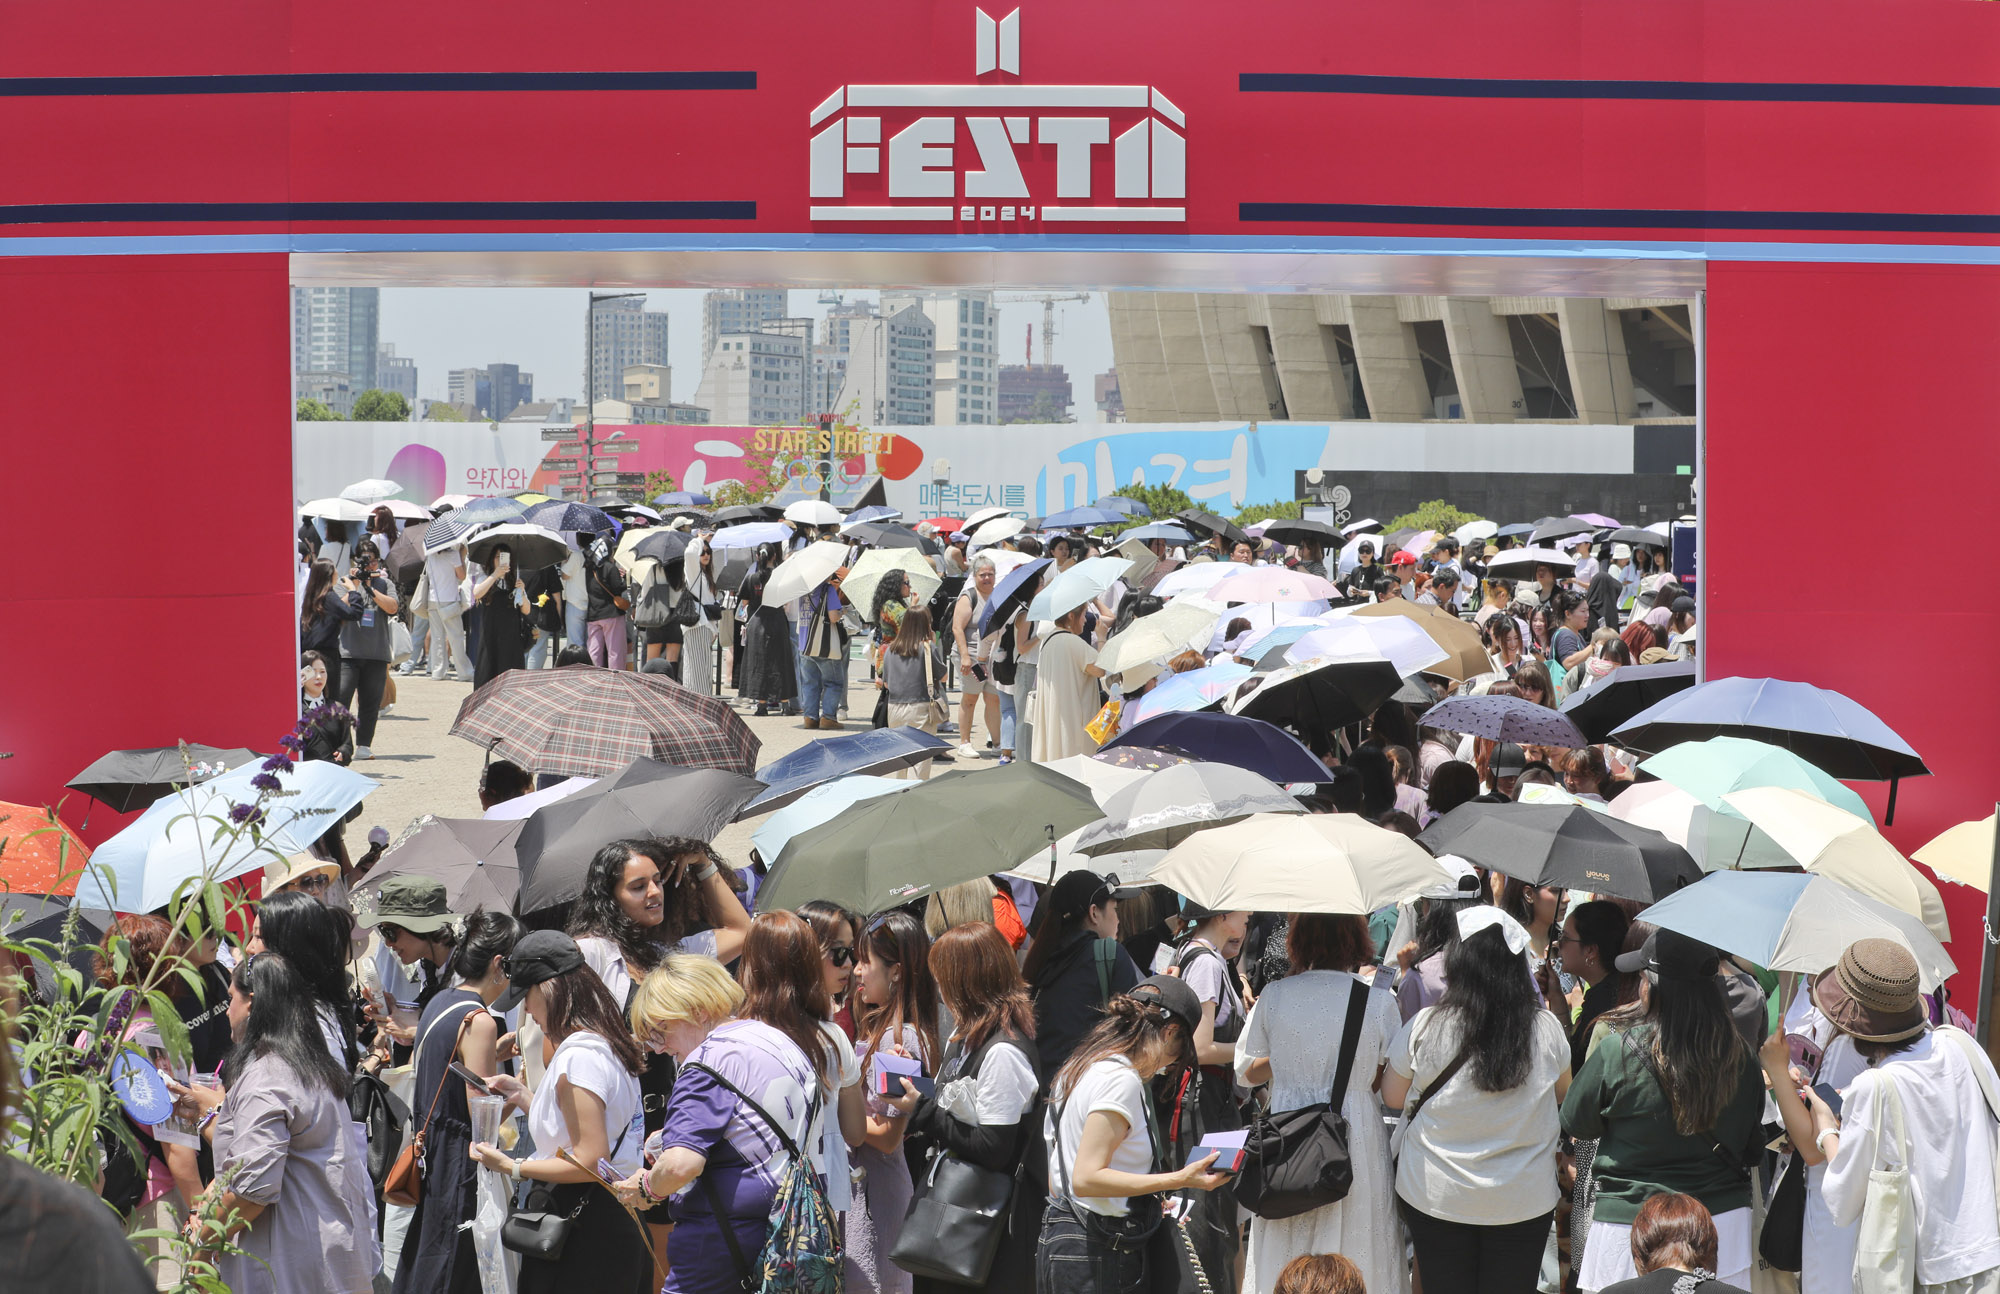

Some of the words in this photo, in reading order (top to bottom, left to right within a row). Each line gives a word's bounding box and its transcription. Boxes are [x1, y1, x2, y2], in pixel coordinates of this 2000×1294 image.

[810, 117, 1186, 198] FESTA
[960, 206, 1036, 221] 2024
[806, 412, 846, 424] OLYMPIC
[754, 428, 808, 452] STAR
[818, 430, 897, 455] STREET
[466, 467, 528, 490] 약자와
[919, 484, 1026, 507] 매력도시를
